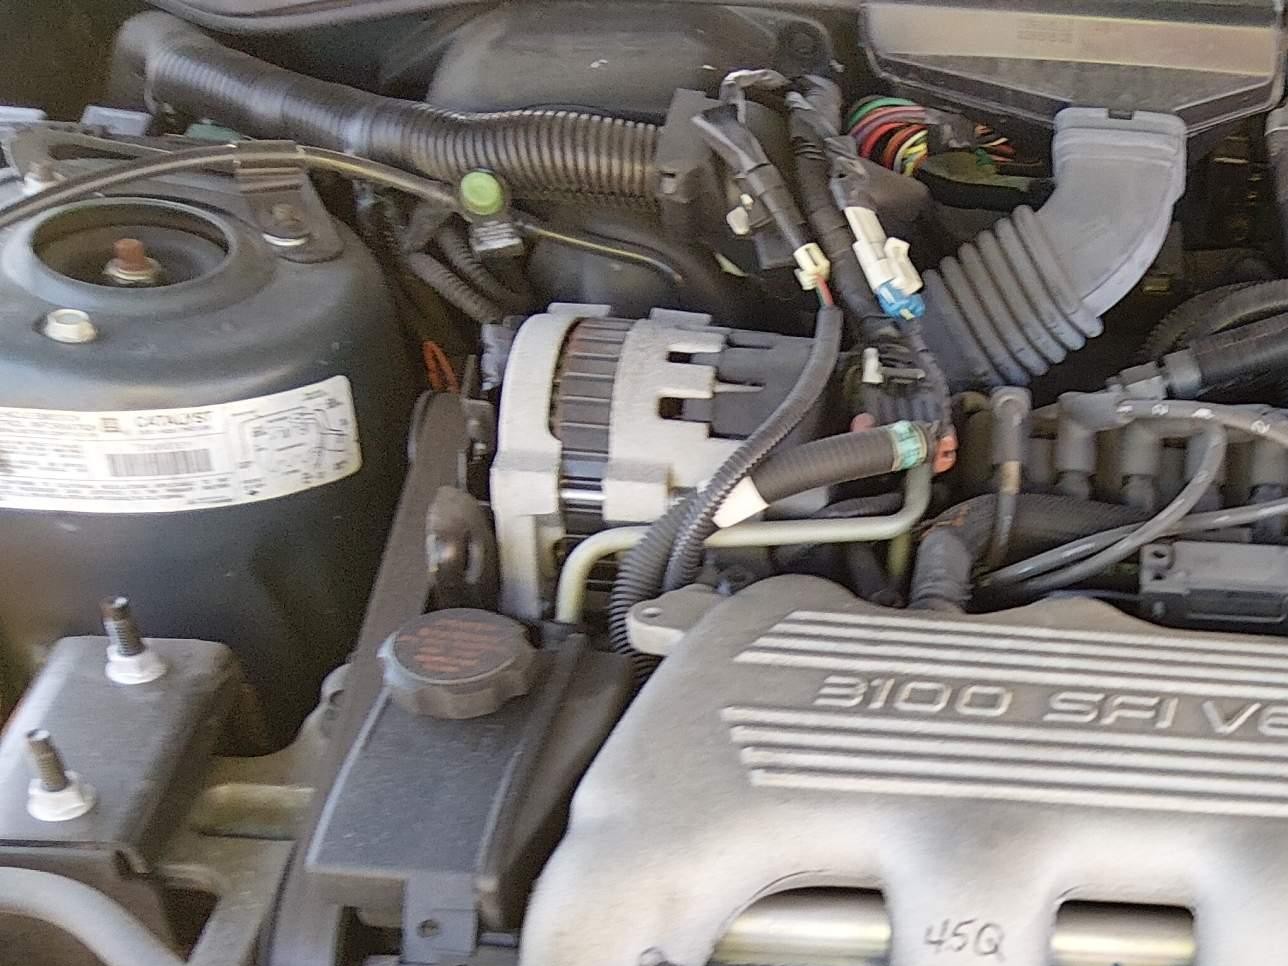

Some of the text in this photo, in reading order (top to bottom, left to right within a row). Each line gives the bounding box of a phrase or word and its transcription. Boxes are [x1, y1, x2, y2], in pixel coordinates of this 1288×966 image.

[135, 410, 212, 428] CATALYST
[812, 674, 1014, 718] 3100
[1042, 691, 1179, 730] SFI
